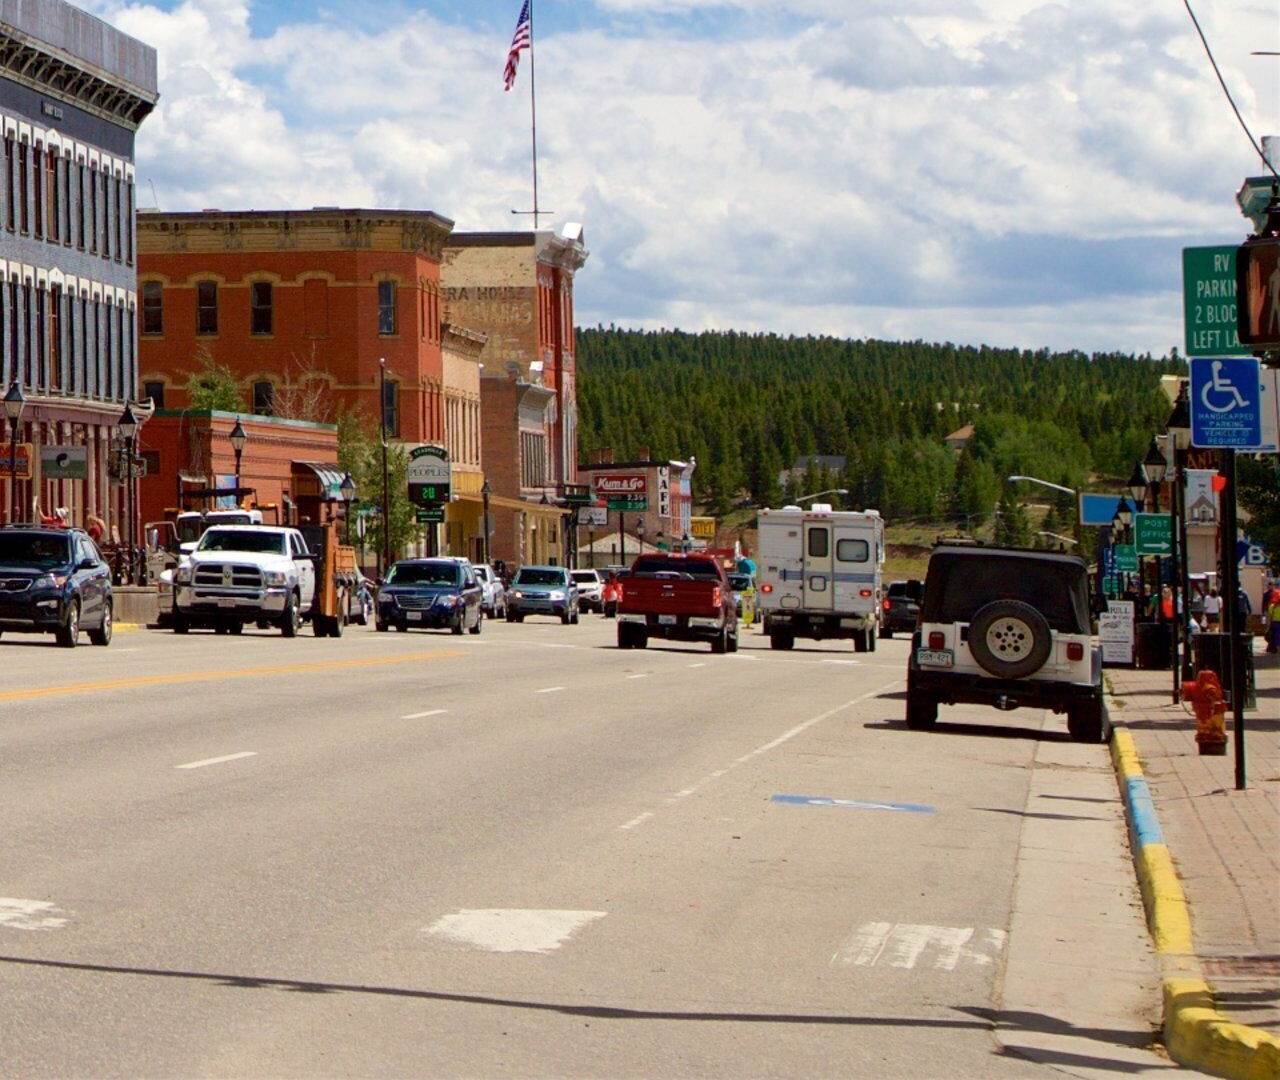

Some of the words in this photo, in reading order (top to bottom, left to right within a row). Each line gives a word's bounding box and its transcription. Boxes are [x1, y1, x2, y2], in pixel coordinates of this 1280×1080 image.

[1214, 254, 1230, 272] RV
[1195, 305, 1202, 323] 2
[1193, 330, 1220, 349] LEFT
[1198, 413, 1255, 421] HANDICAPPED
[598, 478, 621, 490] Kum
[629, 478, 644, 490] Go
[659, 467, 670, 516] CAFE
[1144, 519, 1169, 528] POST
[1141, 530, 1173, 539] OFFICE
[1109, 606, 1130, 614] RILL
